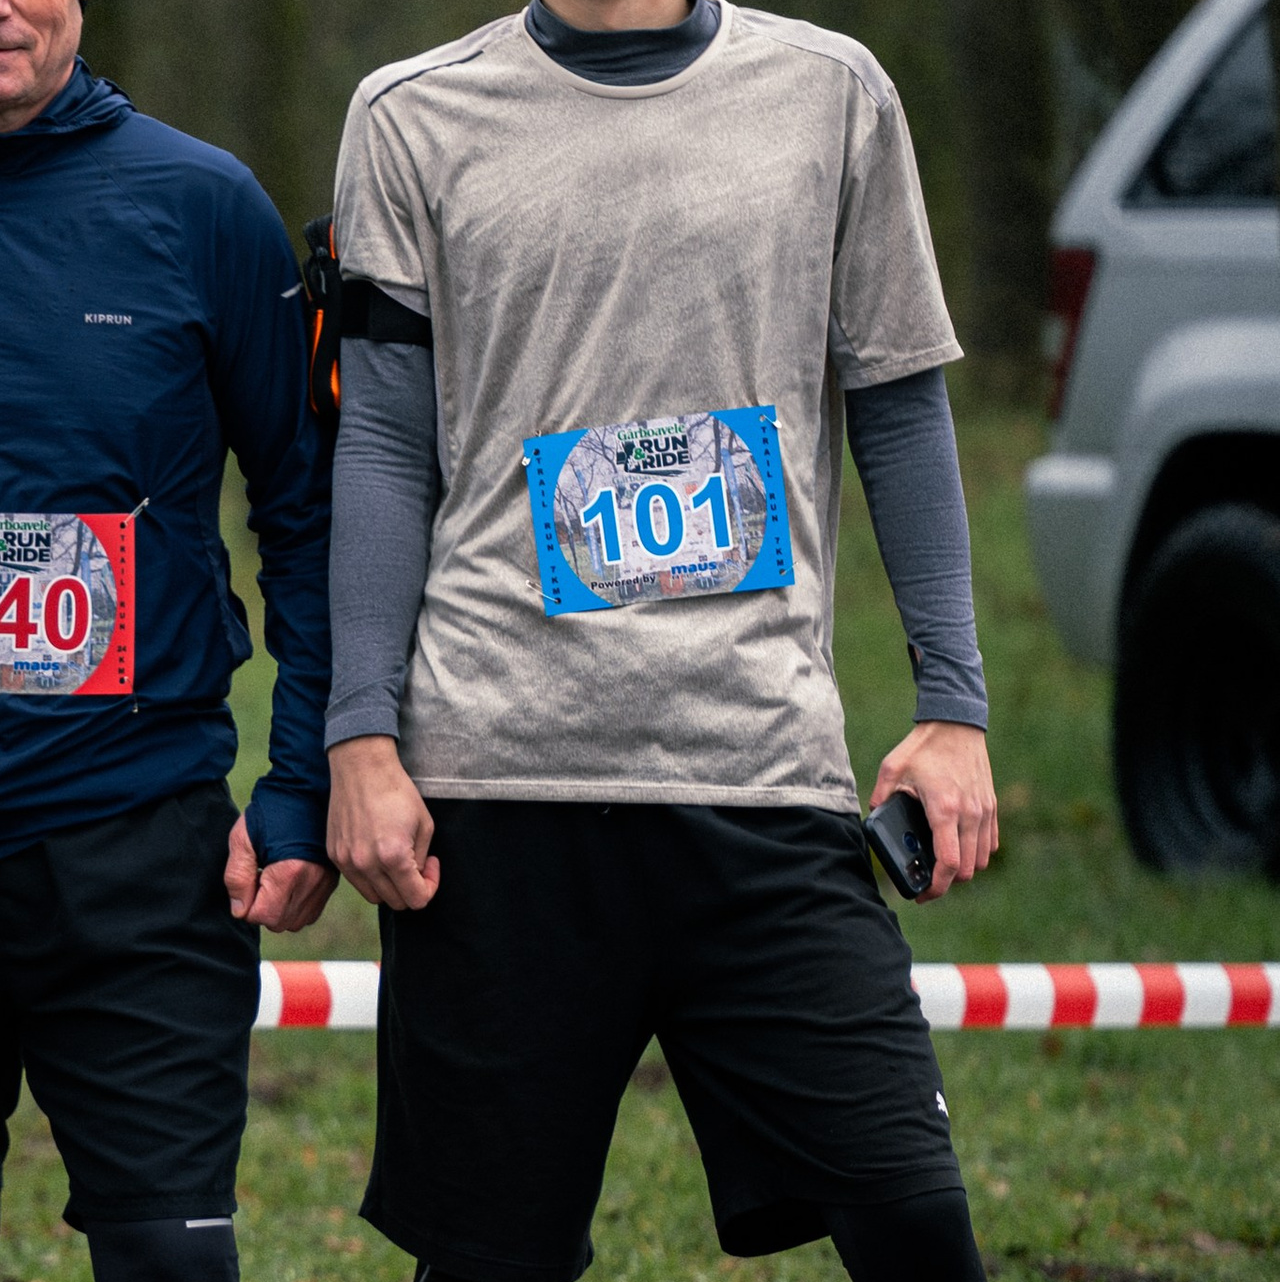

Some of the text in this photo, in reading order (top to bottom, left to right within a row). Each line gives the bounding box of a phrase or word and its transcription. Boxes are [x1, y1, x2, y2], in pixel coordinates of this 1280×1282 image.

[84, 313, 132, 325] KIPRUN
[639, 435, 688, 453] RUN
[642, 450, 691, 469] RIDE
[581, 473, 732, 565] 101
[3, 532, 51, 547] RUN
[3, 548, 51, 562] RIDE
[671, 561, 718, 575] maus
[590, 574, 656, 590] Powered by
[14, 661, 60, 671] maus
